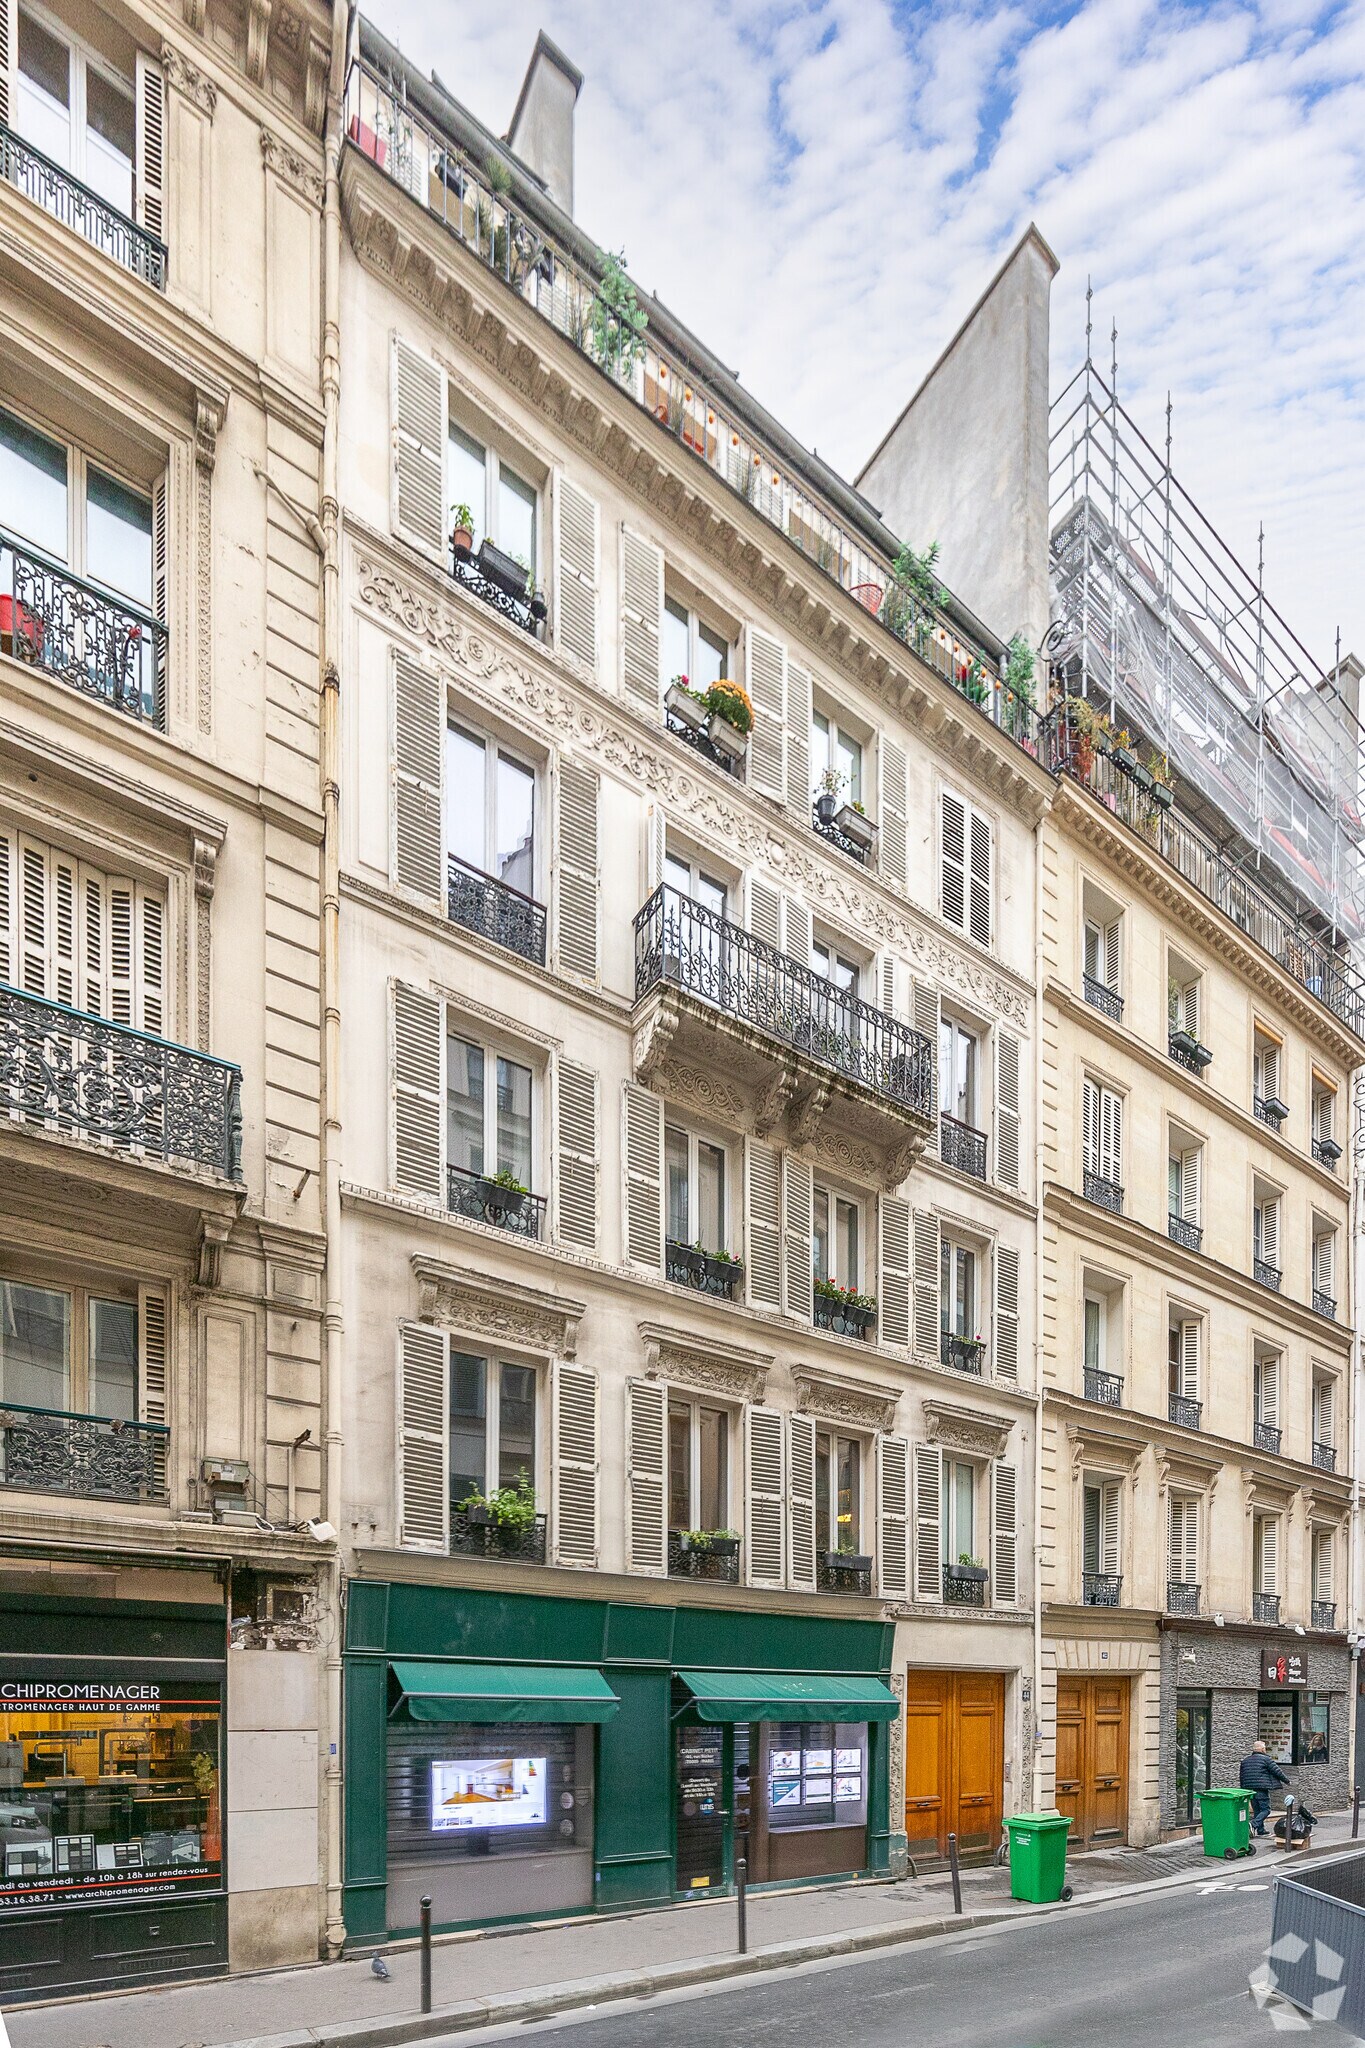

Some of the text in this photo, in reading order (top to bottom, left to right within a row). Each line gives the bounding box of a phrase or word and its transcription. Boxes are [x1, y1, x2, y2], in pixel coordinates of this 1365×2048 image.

[0, 1703, 75, 1711] TROMENAGER
[79, 1703, 105, 1711] HAUT
[33, 1878, 74, 1888] vendredi
[99, 1874, 115, 1882] 10h
[127, 1871, 143, 1879] 18h
[160, 1868, 208, 1877] rendez-vous
[65, 1884, 176, 1899] www.archipromenager.com
